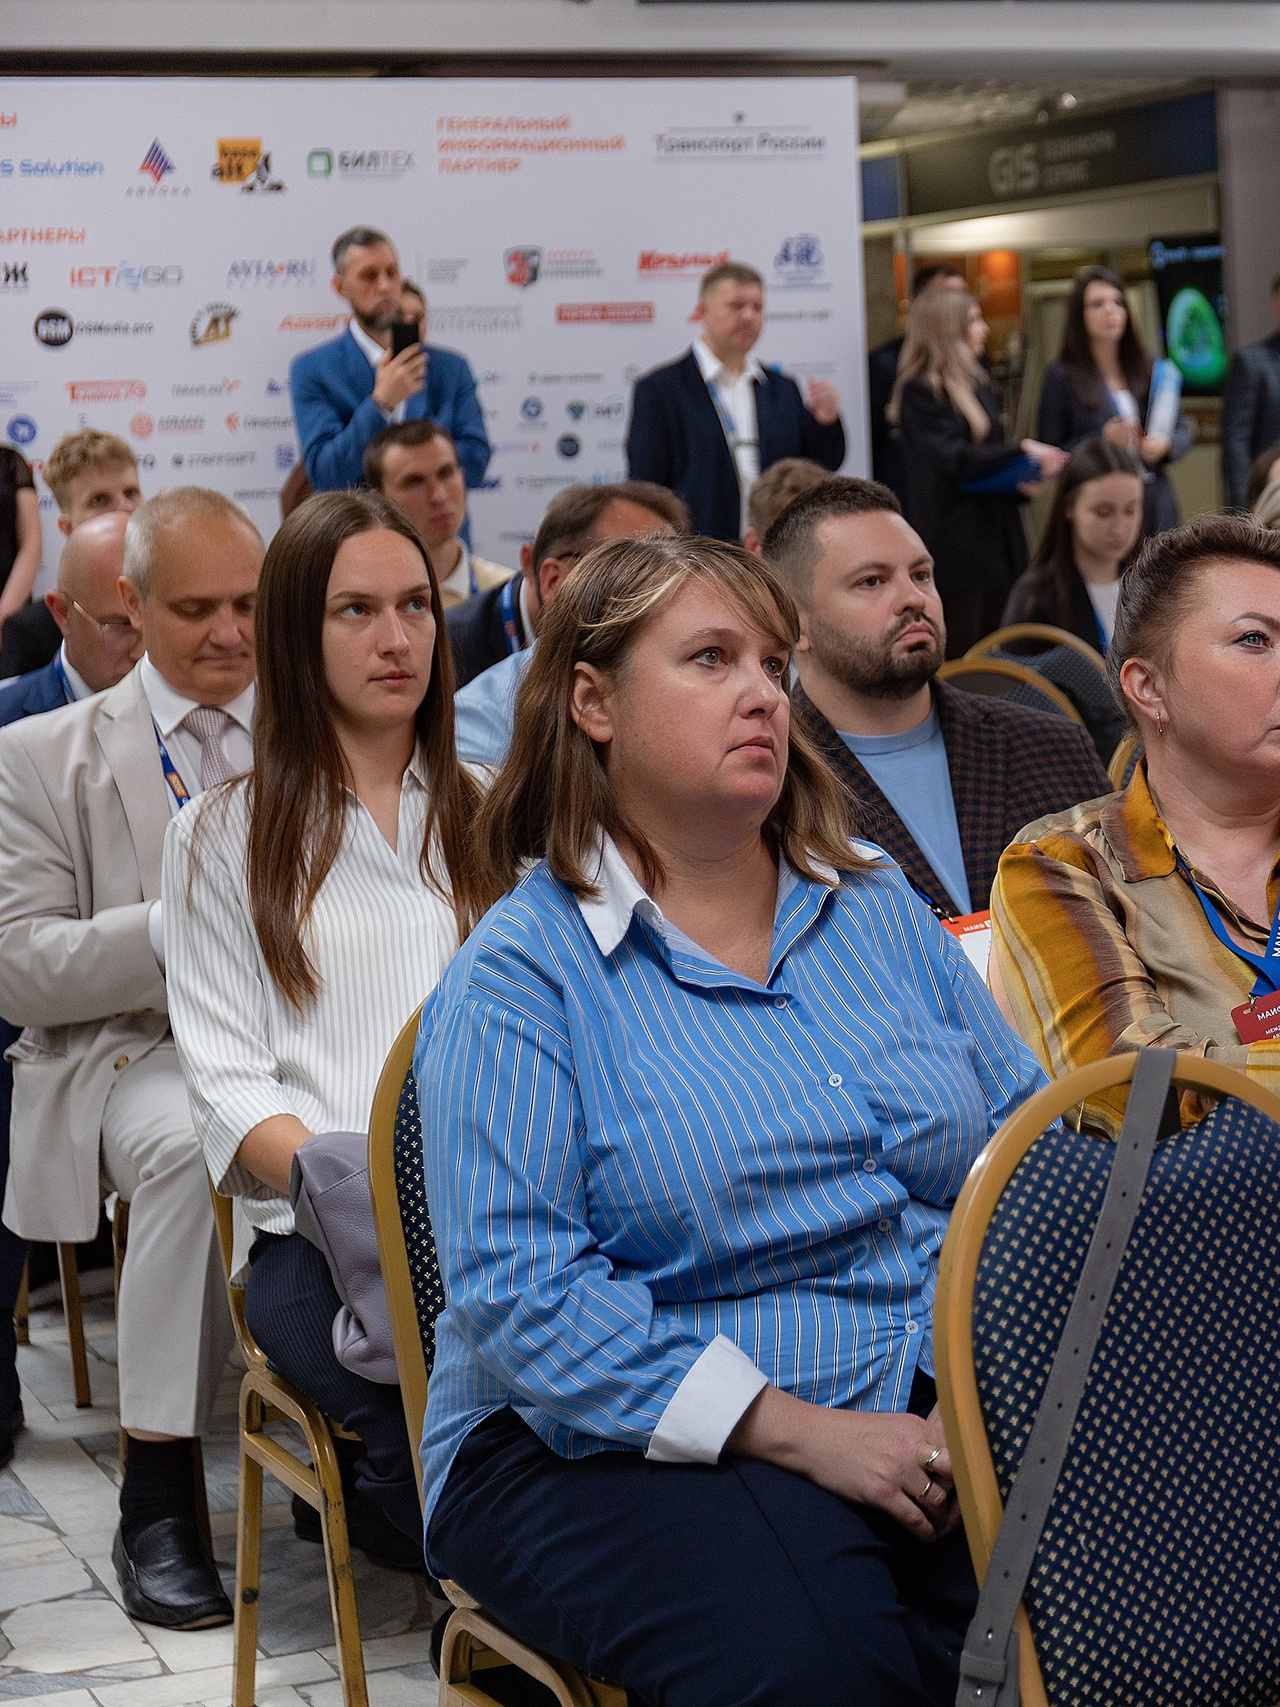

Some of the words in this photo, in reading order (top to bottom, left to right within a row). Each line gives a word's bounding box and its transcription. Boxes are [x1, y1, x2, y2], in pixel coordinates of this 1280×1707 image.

[437, 114, 571, 132] ГЕНЕРАЛЬНЫЙ
[438, 133, 625, 154] ИНФОРМАЦИОННЫЙ
[438, 158, 522, 173] ПАРТНЕР
